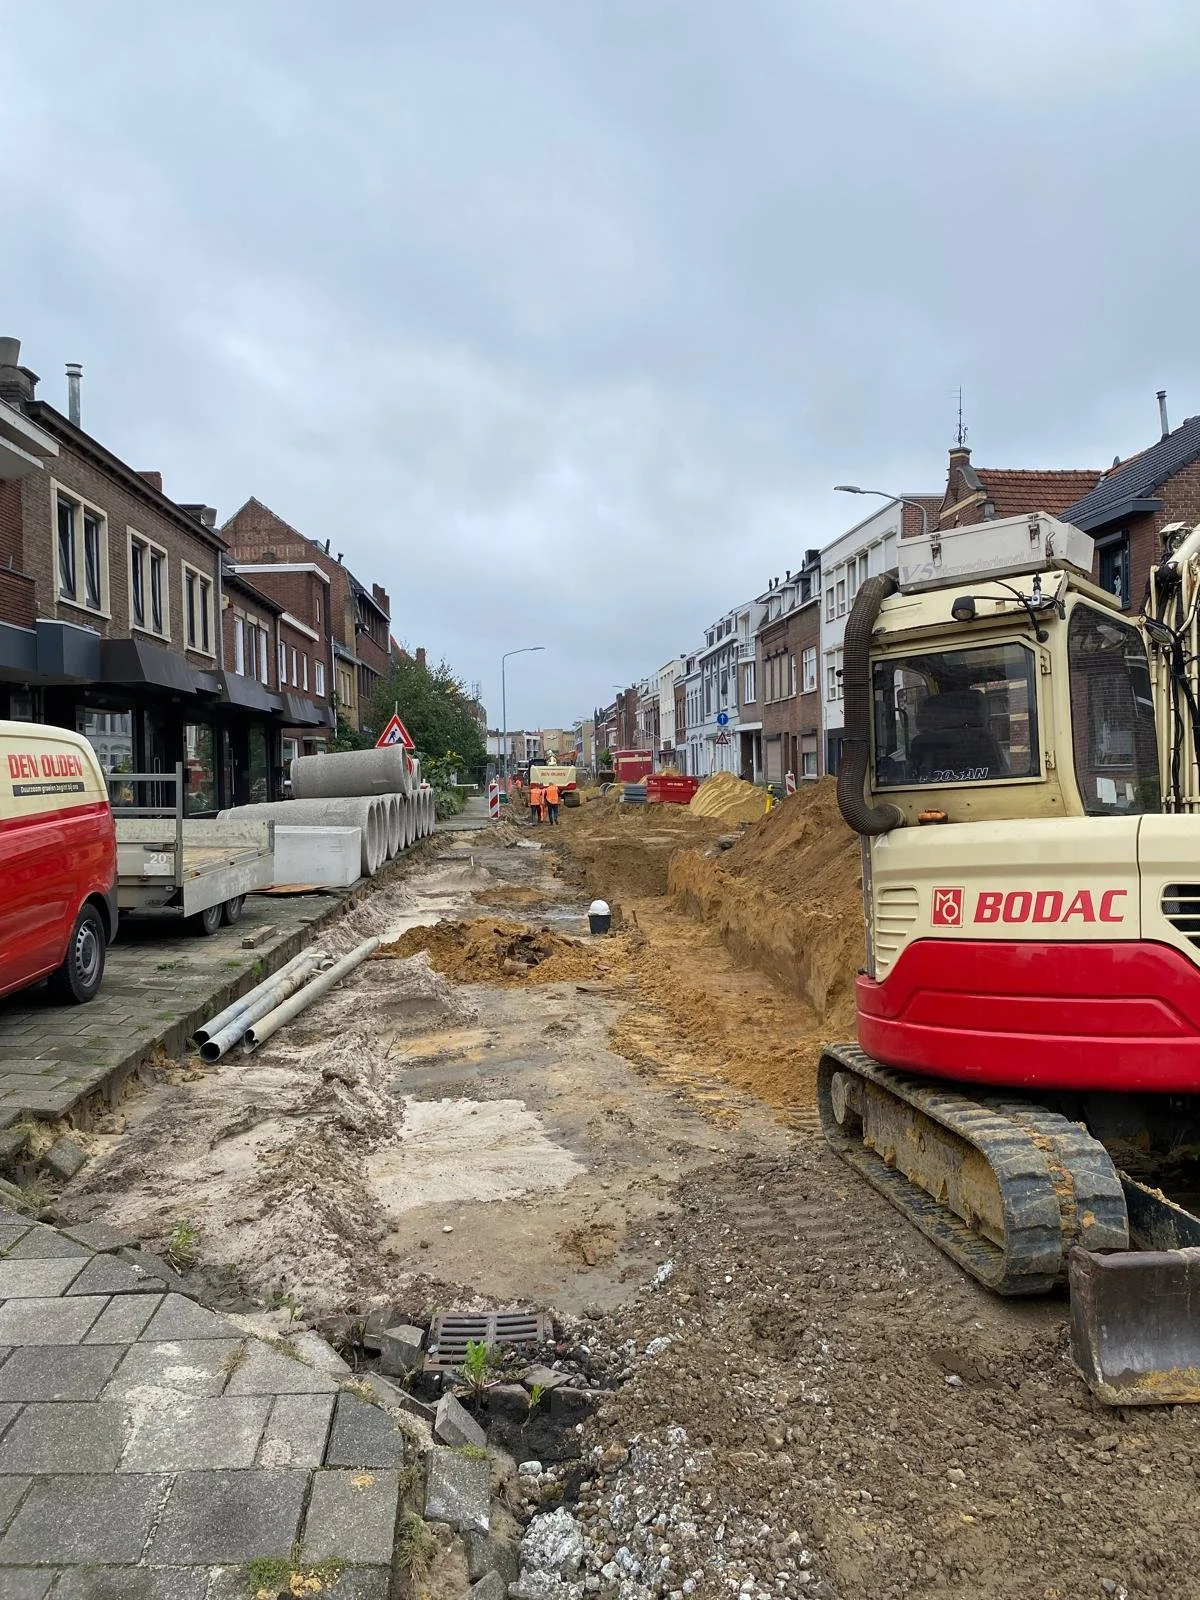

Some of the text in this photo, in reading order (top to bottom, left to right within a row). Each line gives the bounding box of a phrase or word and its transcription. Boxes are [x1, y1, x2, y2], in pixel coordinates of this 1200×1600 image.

[8, 754, 83, 778] DEN OUDEN
[150, 853, 166, 864] 20
[973, 889, 1128, 923] BODAC
